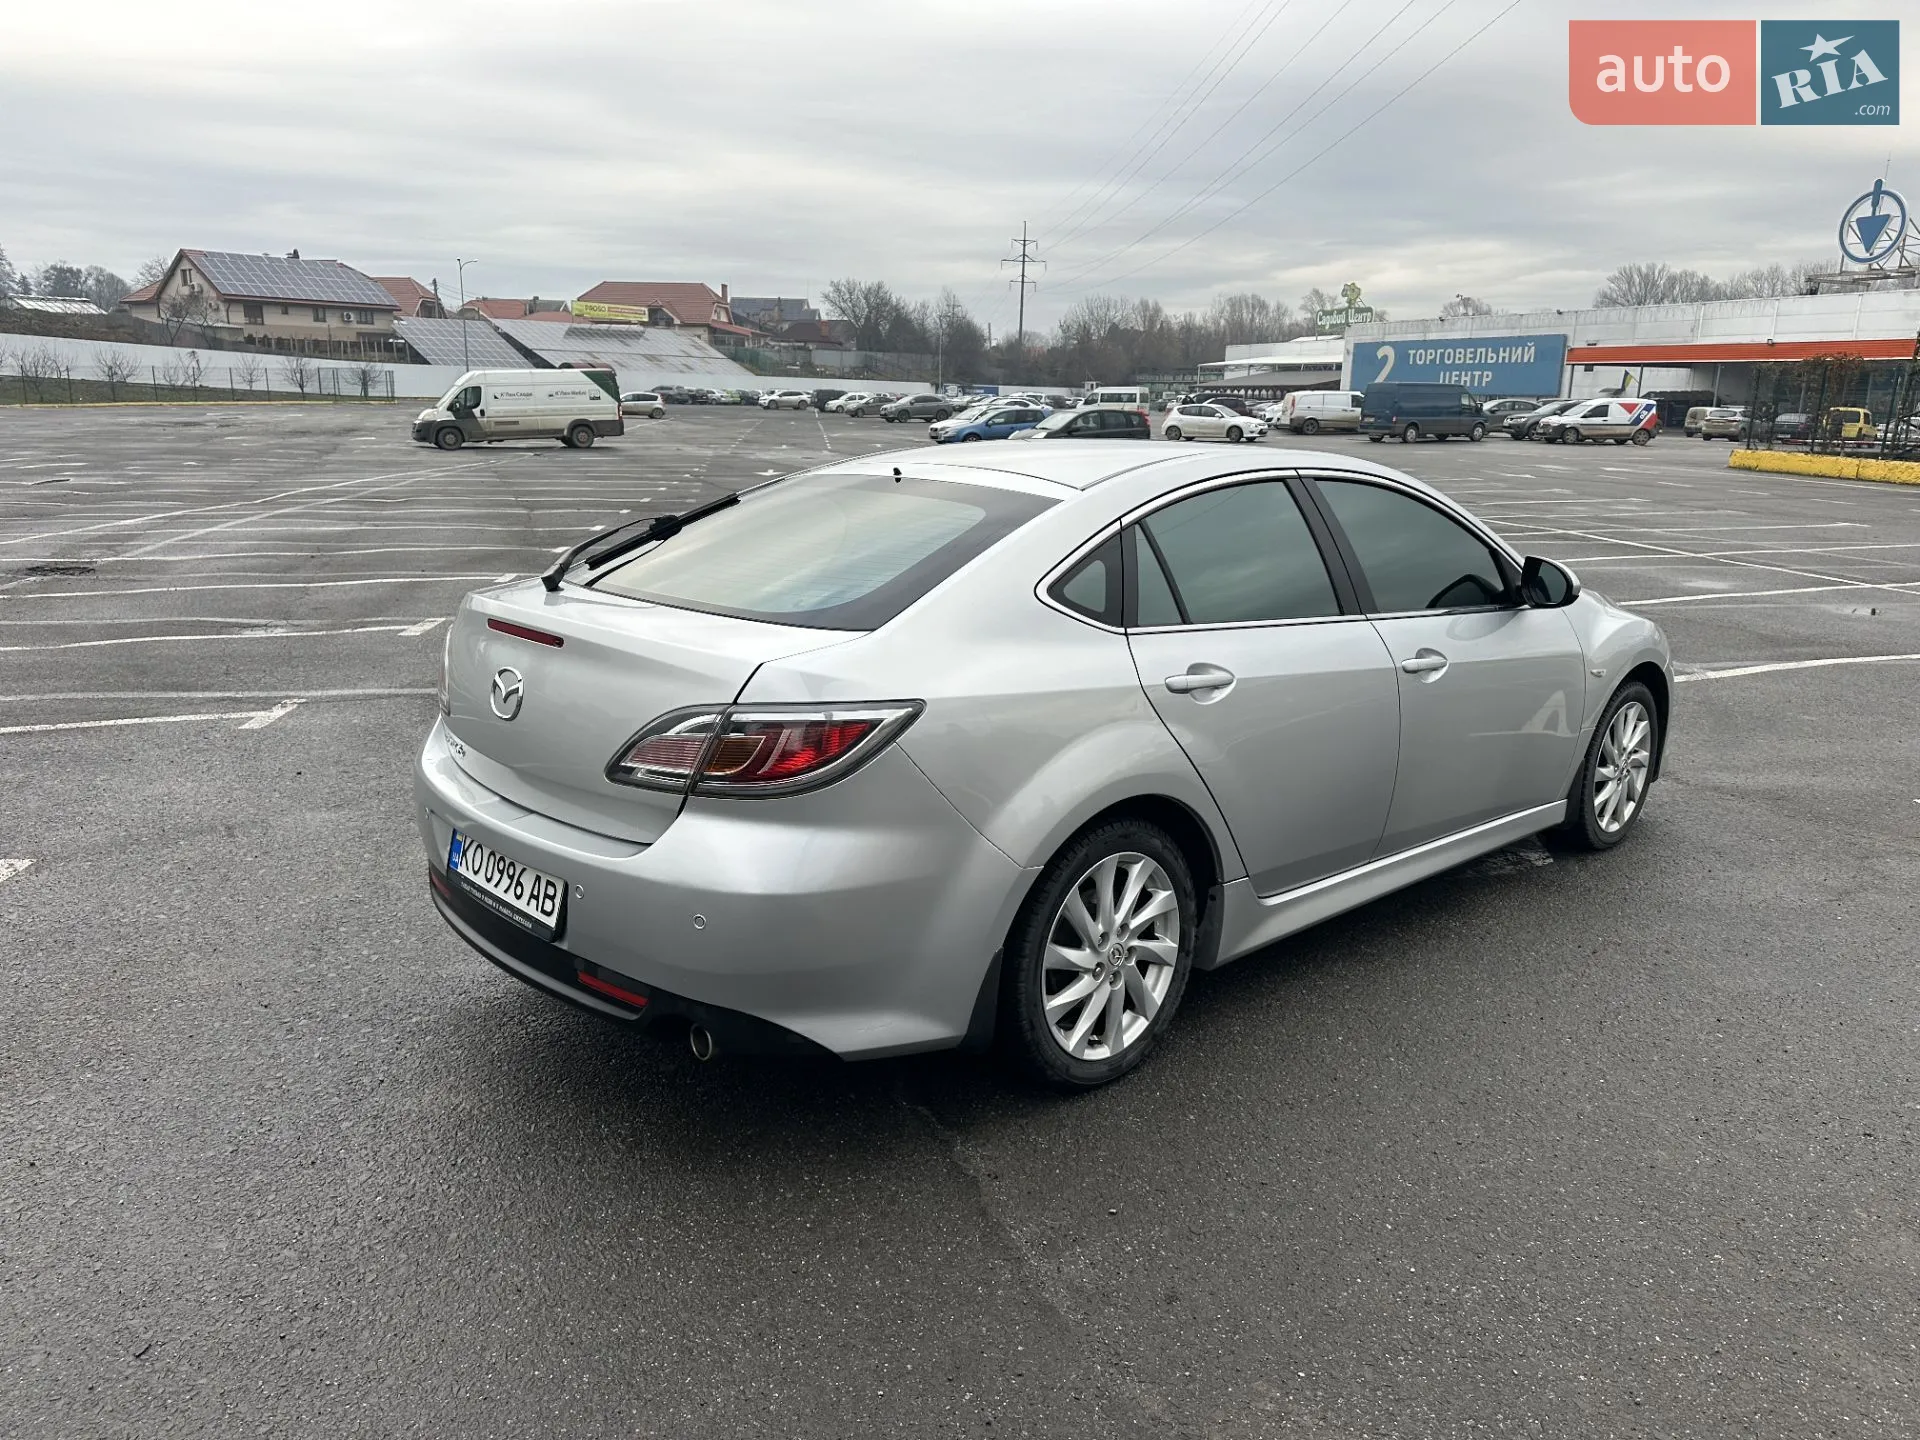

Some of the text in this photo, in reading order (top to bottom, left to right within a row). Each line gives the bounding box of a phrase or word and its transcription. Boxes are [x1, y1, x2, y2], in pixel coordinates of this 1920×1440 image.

[1374, 345, 1396, 383] 2
[1408, 342, 1536, 365] ТОРГОВЕЛЬНИЙ
[485, 850, 527, 901] 0996
